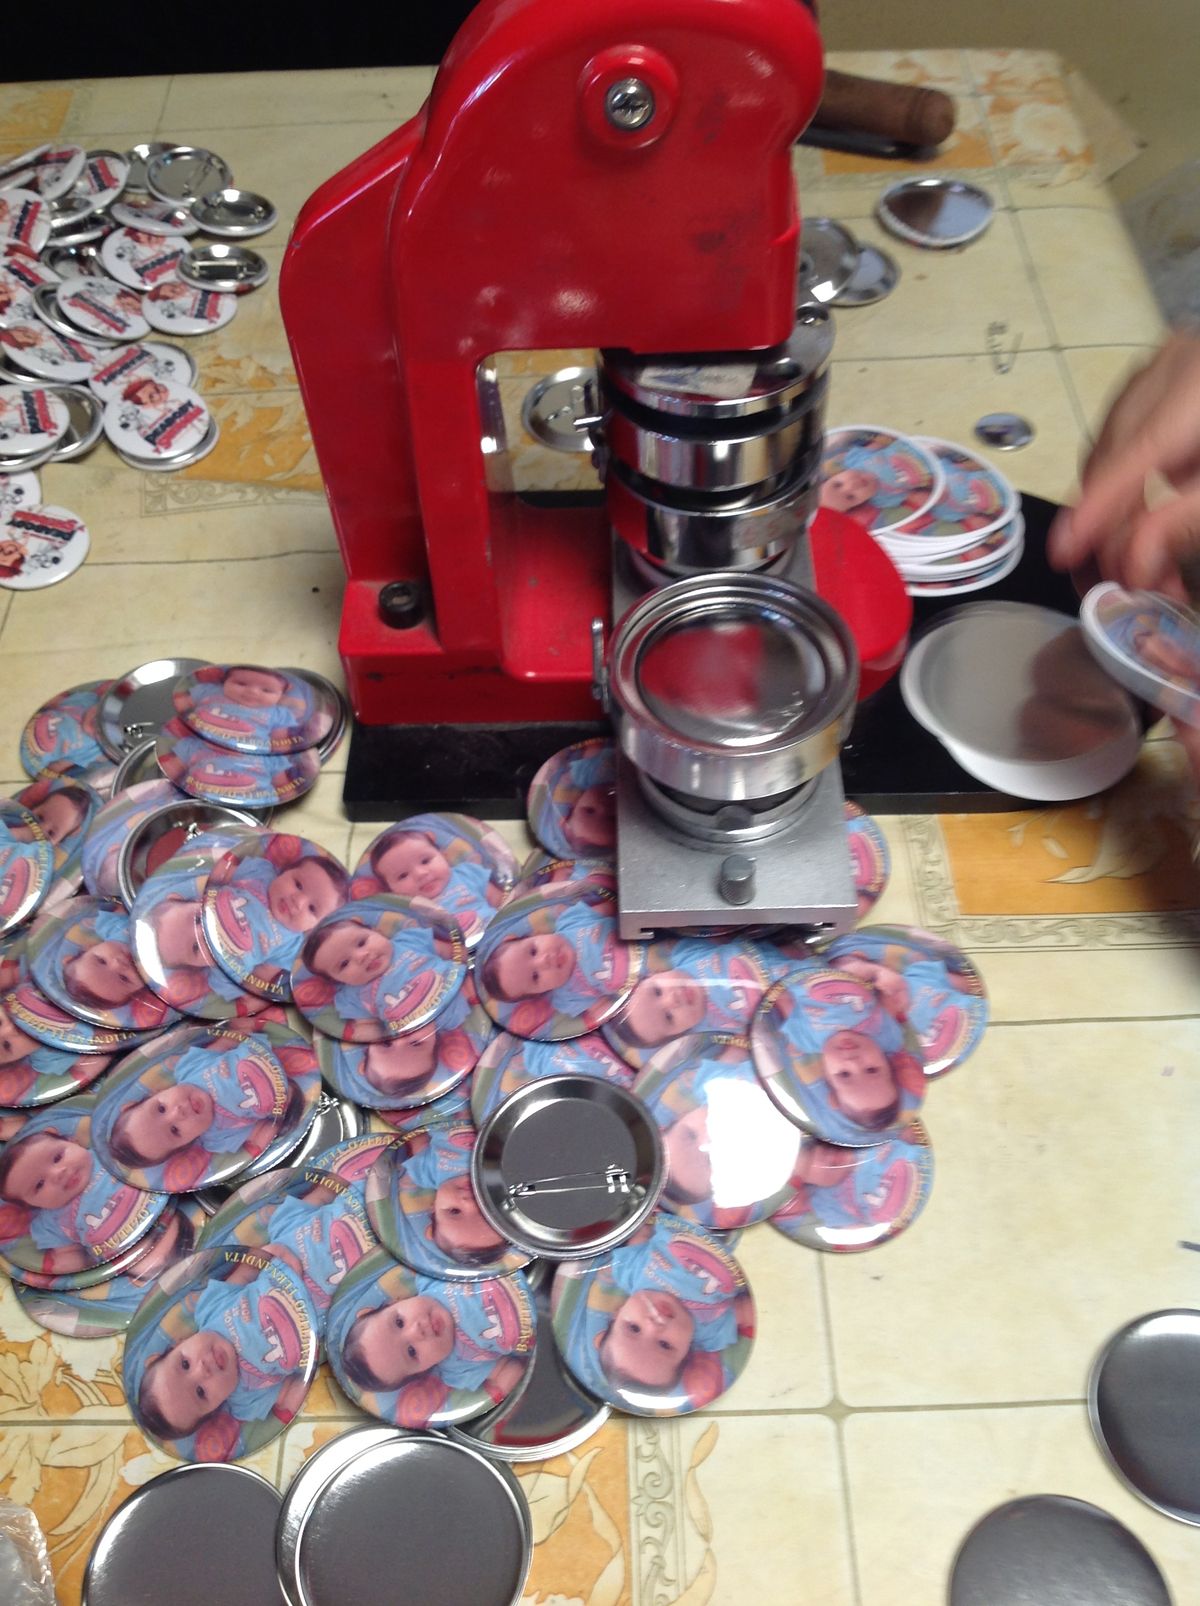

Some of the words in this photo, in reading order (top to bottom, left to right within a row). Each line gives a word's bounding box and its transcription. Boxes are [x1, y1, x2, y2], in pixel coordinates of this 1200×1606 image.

[144, 400, 194, 446] PEABODY
[272, 1065, 288, 1115] BAUTIZO
[304, 1172, 370, 1225] FERNANDITA
[225, 1252, 300, 1298] FERNANDITA
[295, 1299, 312, 1367] BAUTIZO
[516, 1289, 534, 1352] BAUTIZO
